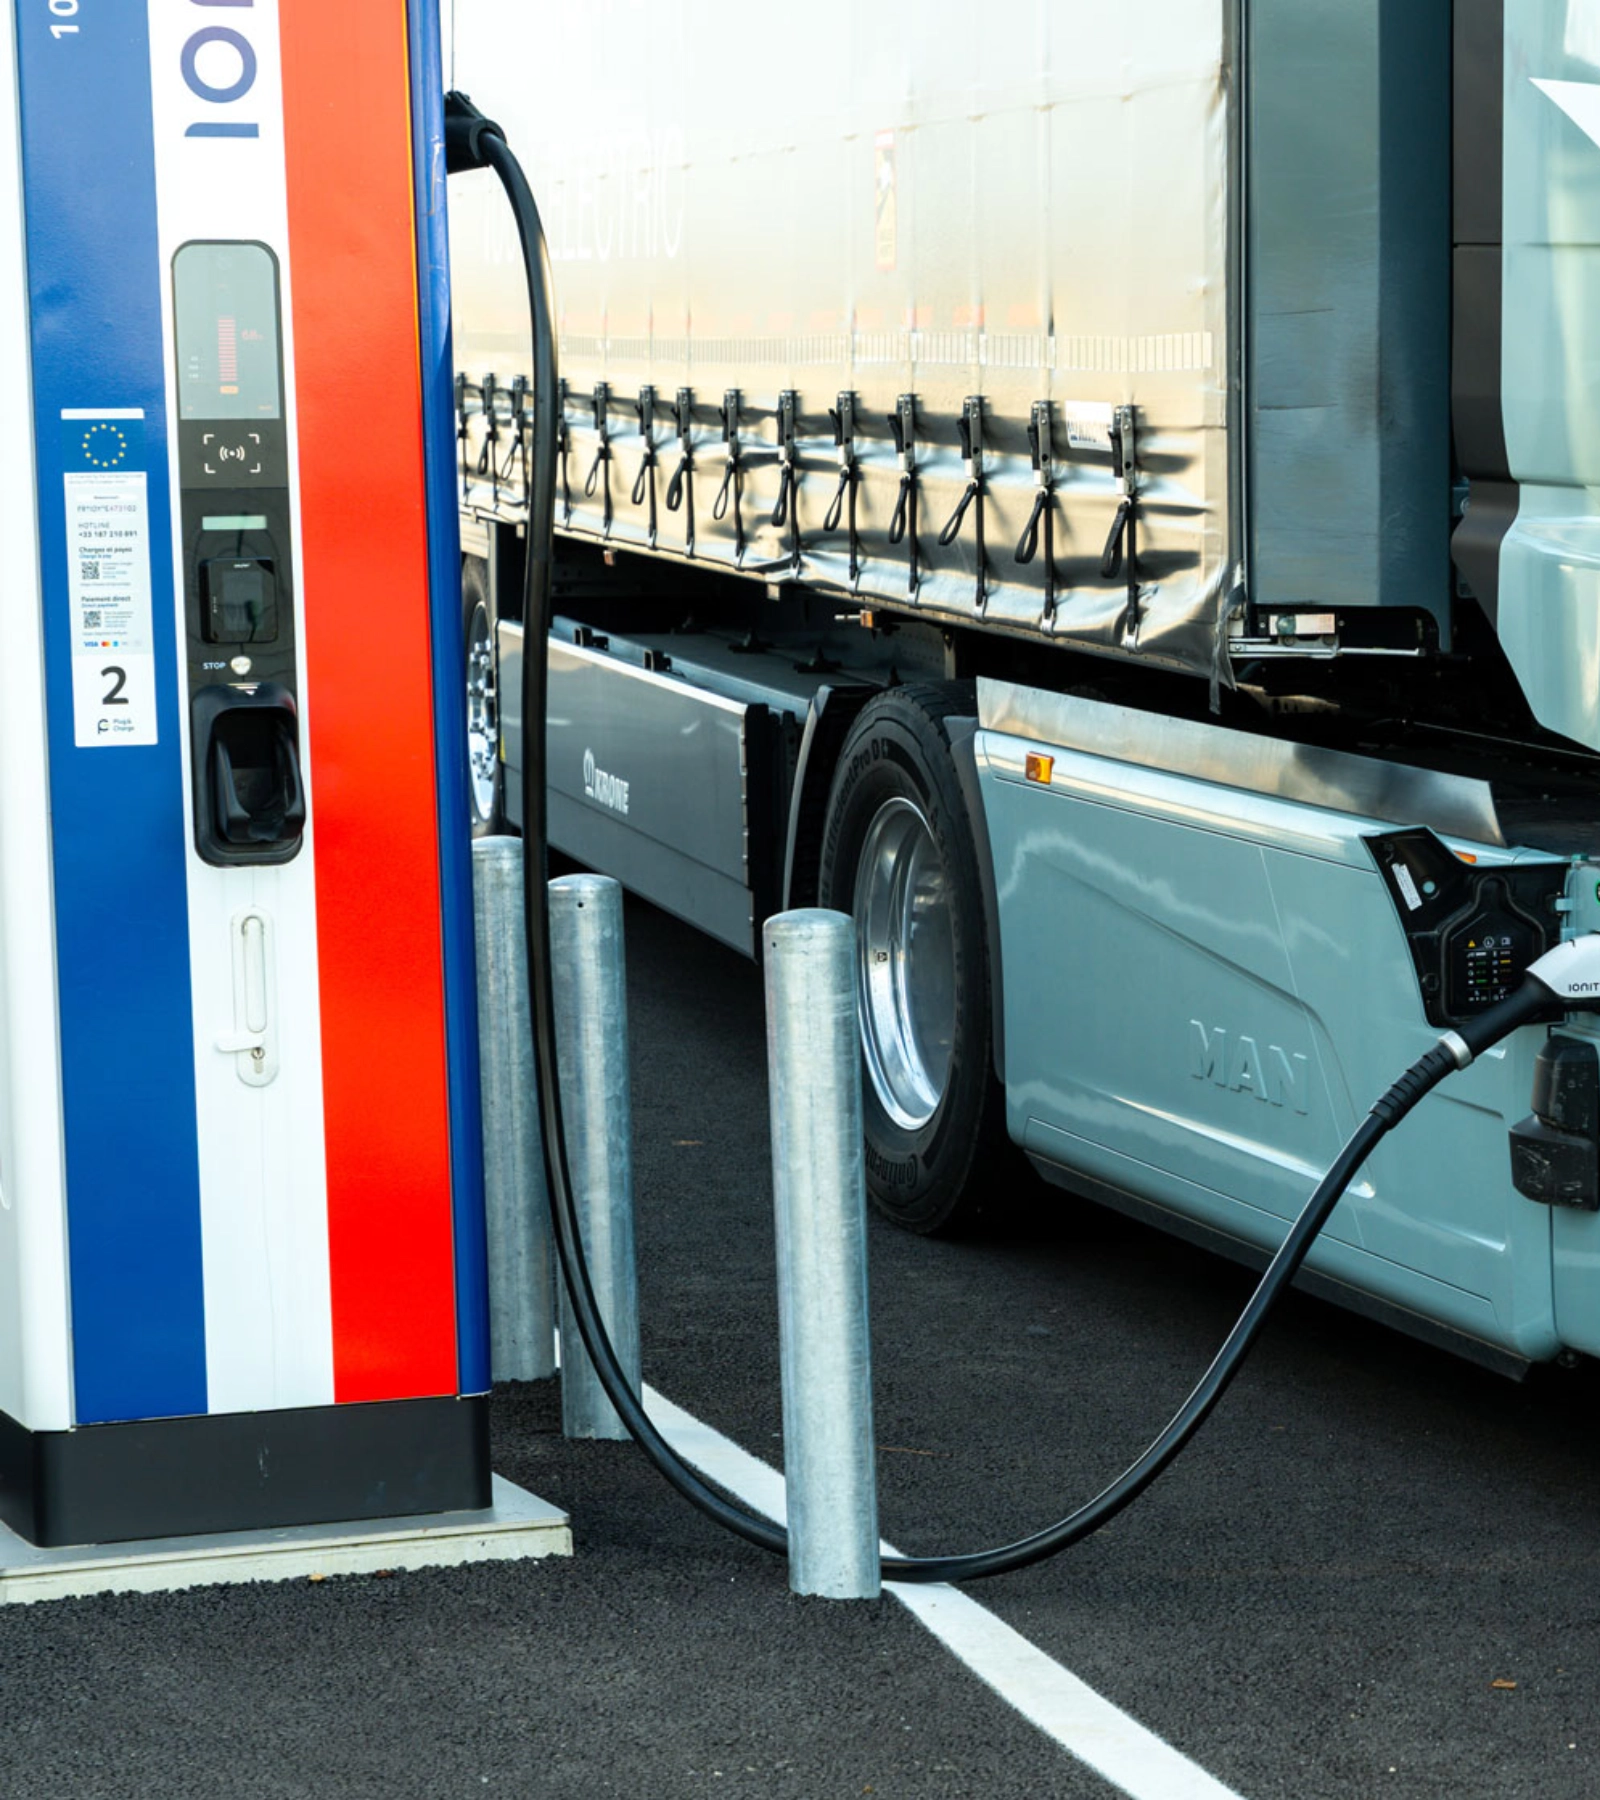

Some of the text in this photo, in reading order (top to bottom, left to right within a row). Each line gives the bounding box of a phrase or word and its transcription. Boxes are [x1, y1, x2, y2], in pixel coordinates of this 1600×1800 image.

[180, 0, 260, 138] IO
[100, 665, 130, 705] 2
[202, 661, 227, 671] STOP
[595, 768, 630, 817] KRONE
[1190, 1019, 1309, 1117] MAN
